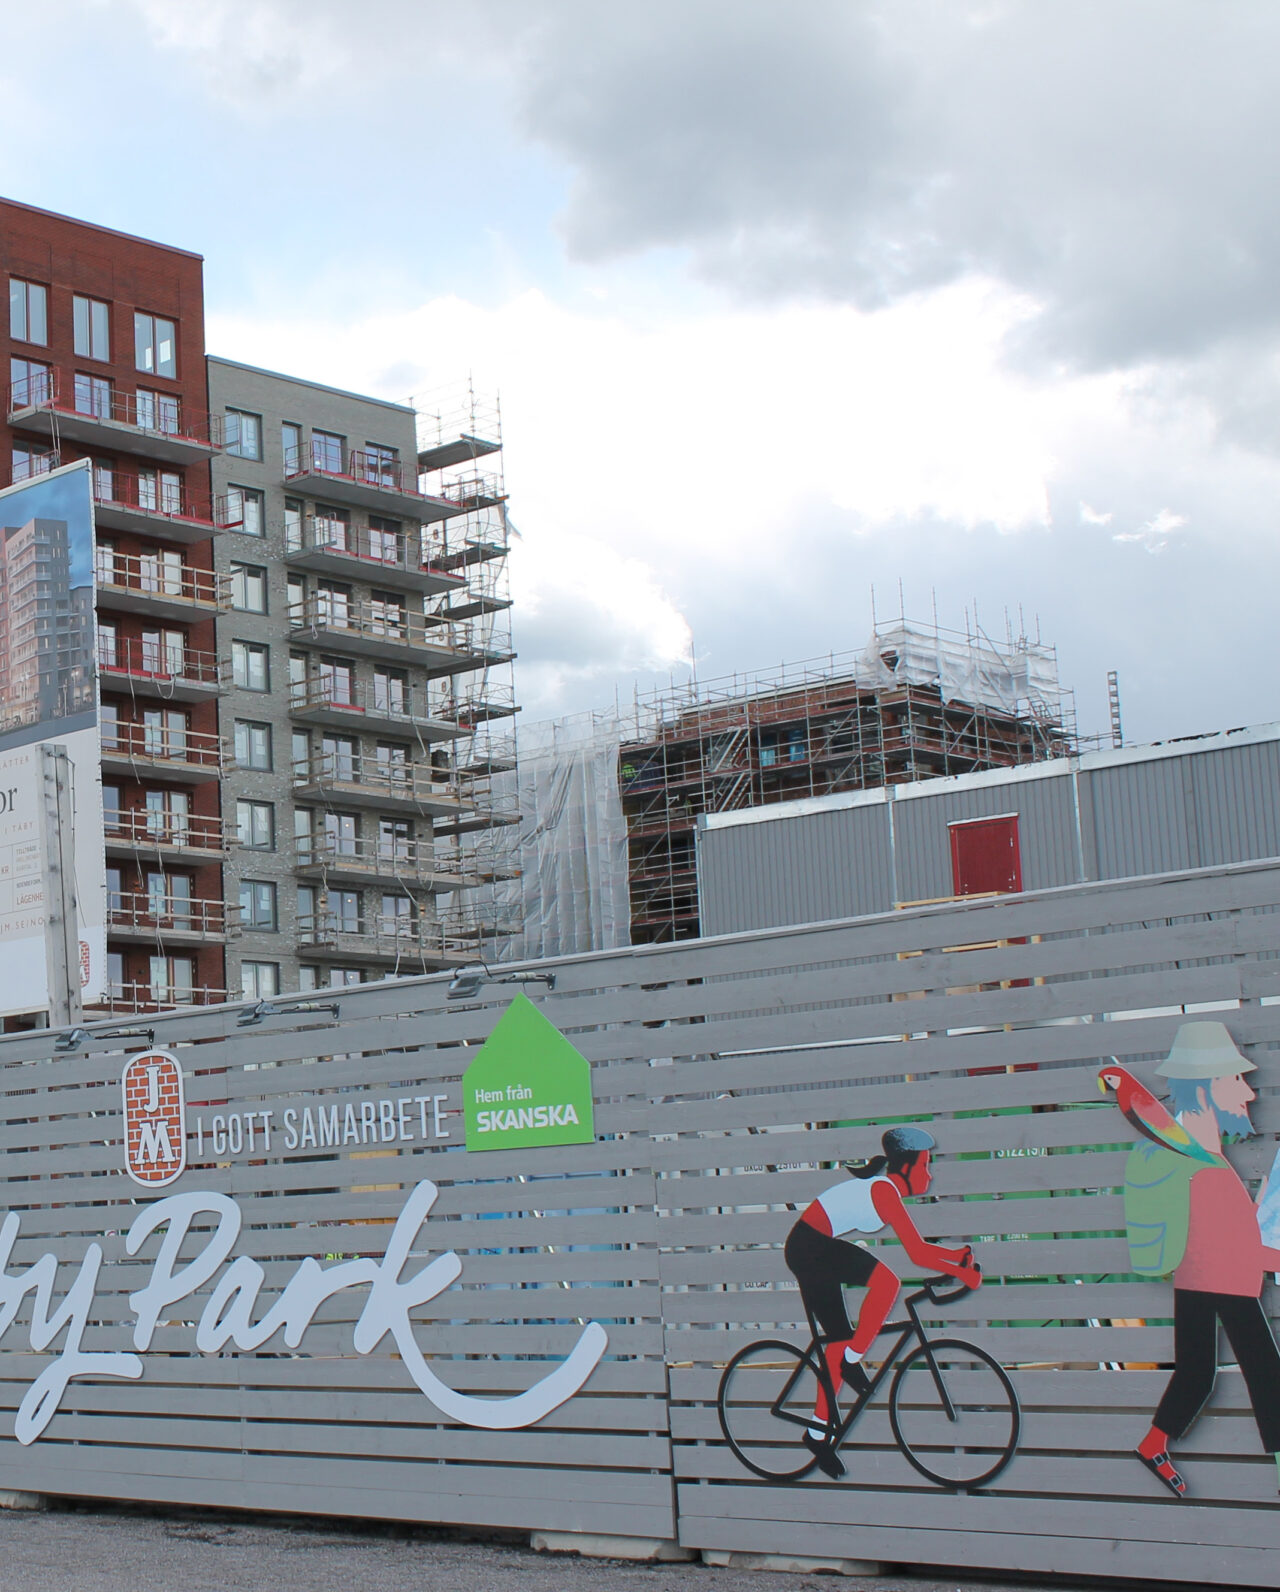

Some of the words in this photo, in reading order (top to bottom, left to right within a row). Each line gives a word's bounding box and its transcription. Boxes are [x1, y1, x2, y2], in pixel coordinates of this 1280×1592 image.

[475, 1087, 504, 1105] Hem
[505, 1083, 532, 1102] från
[197, 1116, 205, 1156] I
[212, 1110, 274, 1156] GOTT
[283, 1094, 451, 1150] SAMARBETE
[476, 1103, 579, 1133] SKANSKA
[125, 1178, 608, 1429] Park
